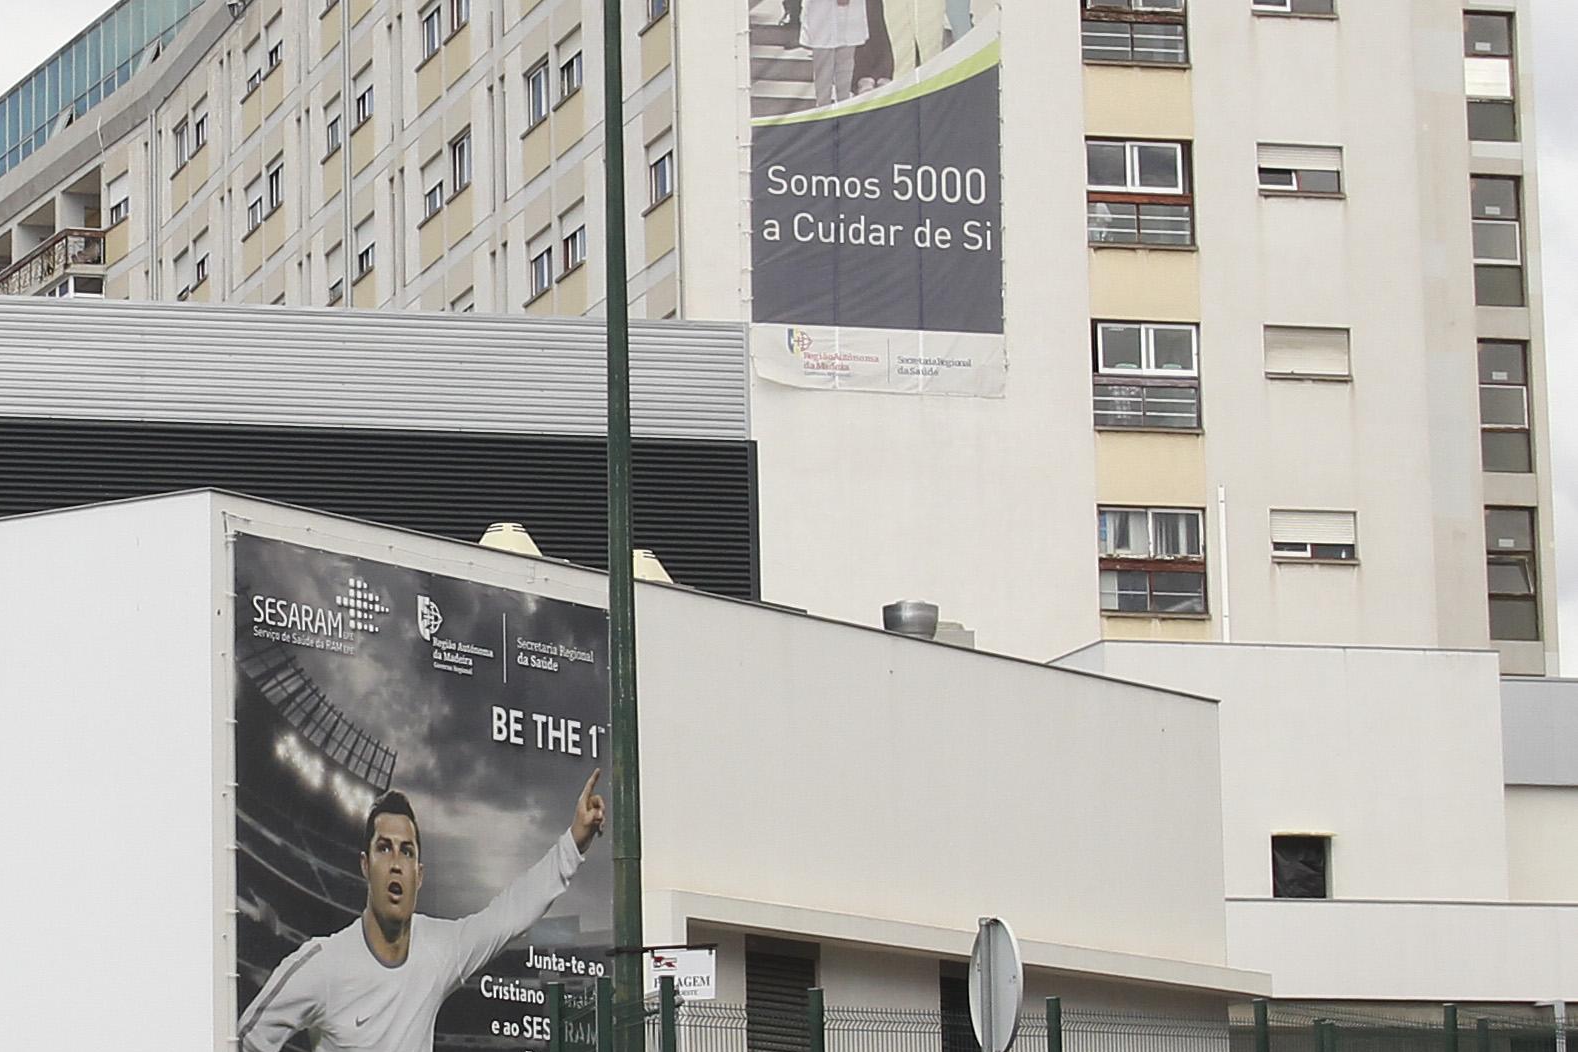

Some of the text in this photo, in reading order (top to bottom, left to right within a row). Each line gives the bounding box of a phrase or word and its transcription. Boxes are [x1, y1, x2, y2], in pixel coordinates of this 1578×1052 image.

[767, 163, 986, 204] Somos 5000
[762, 212, 992, 251] a Cuidar de Si
[253, 595, 342, 638] SESARAM
[253, 625, 280, 641] Serviço
[282, 631, 290, 642] de
[293, 632, 314, 647] Saúde
[315, 639, 324, 649] da
[432, 637, 494, 658] Região Autónoma
[517, 637, 594, 663] Secretaria Regional
[433, 650, 473, 666] da Madeira
[517, 652, 558, 671] da Saúde
[492, 705, 524, 745] BE
[532, 713, 582, 755] THE
[526, 945, 605, 977] Junta-te ao
[480, 974, 545, 1005] Cristiano
[491, 1015, 597, 1046] e ao SESRAM
